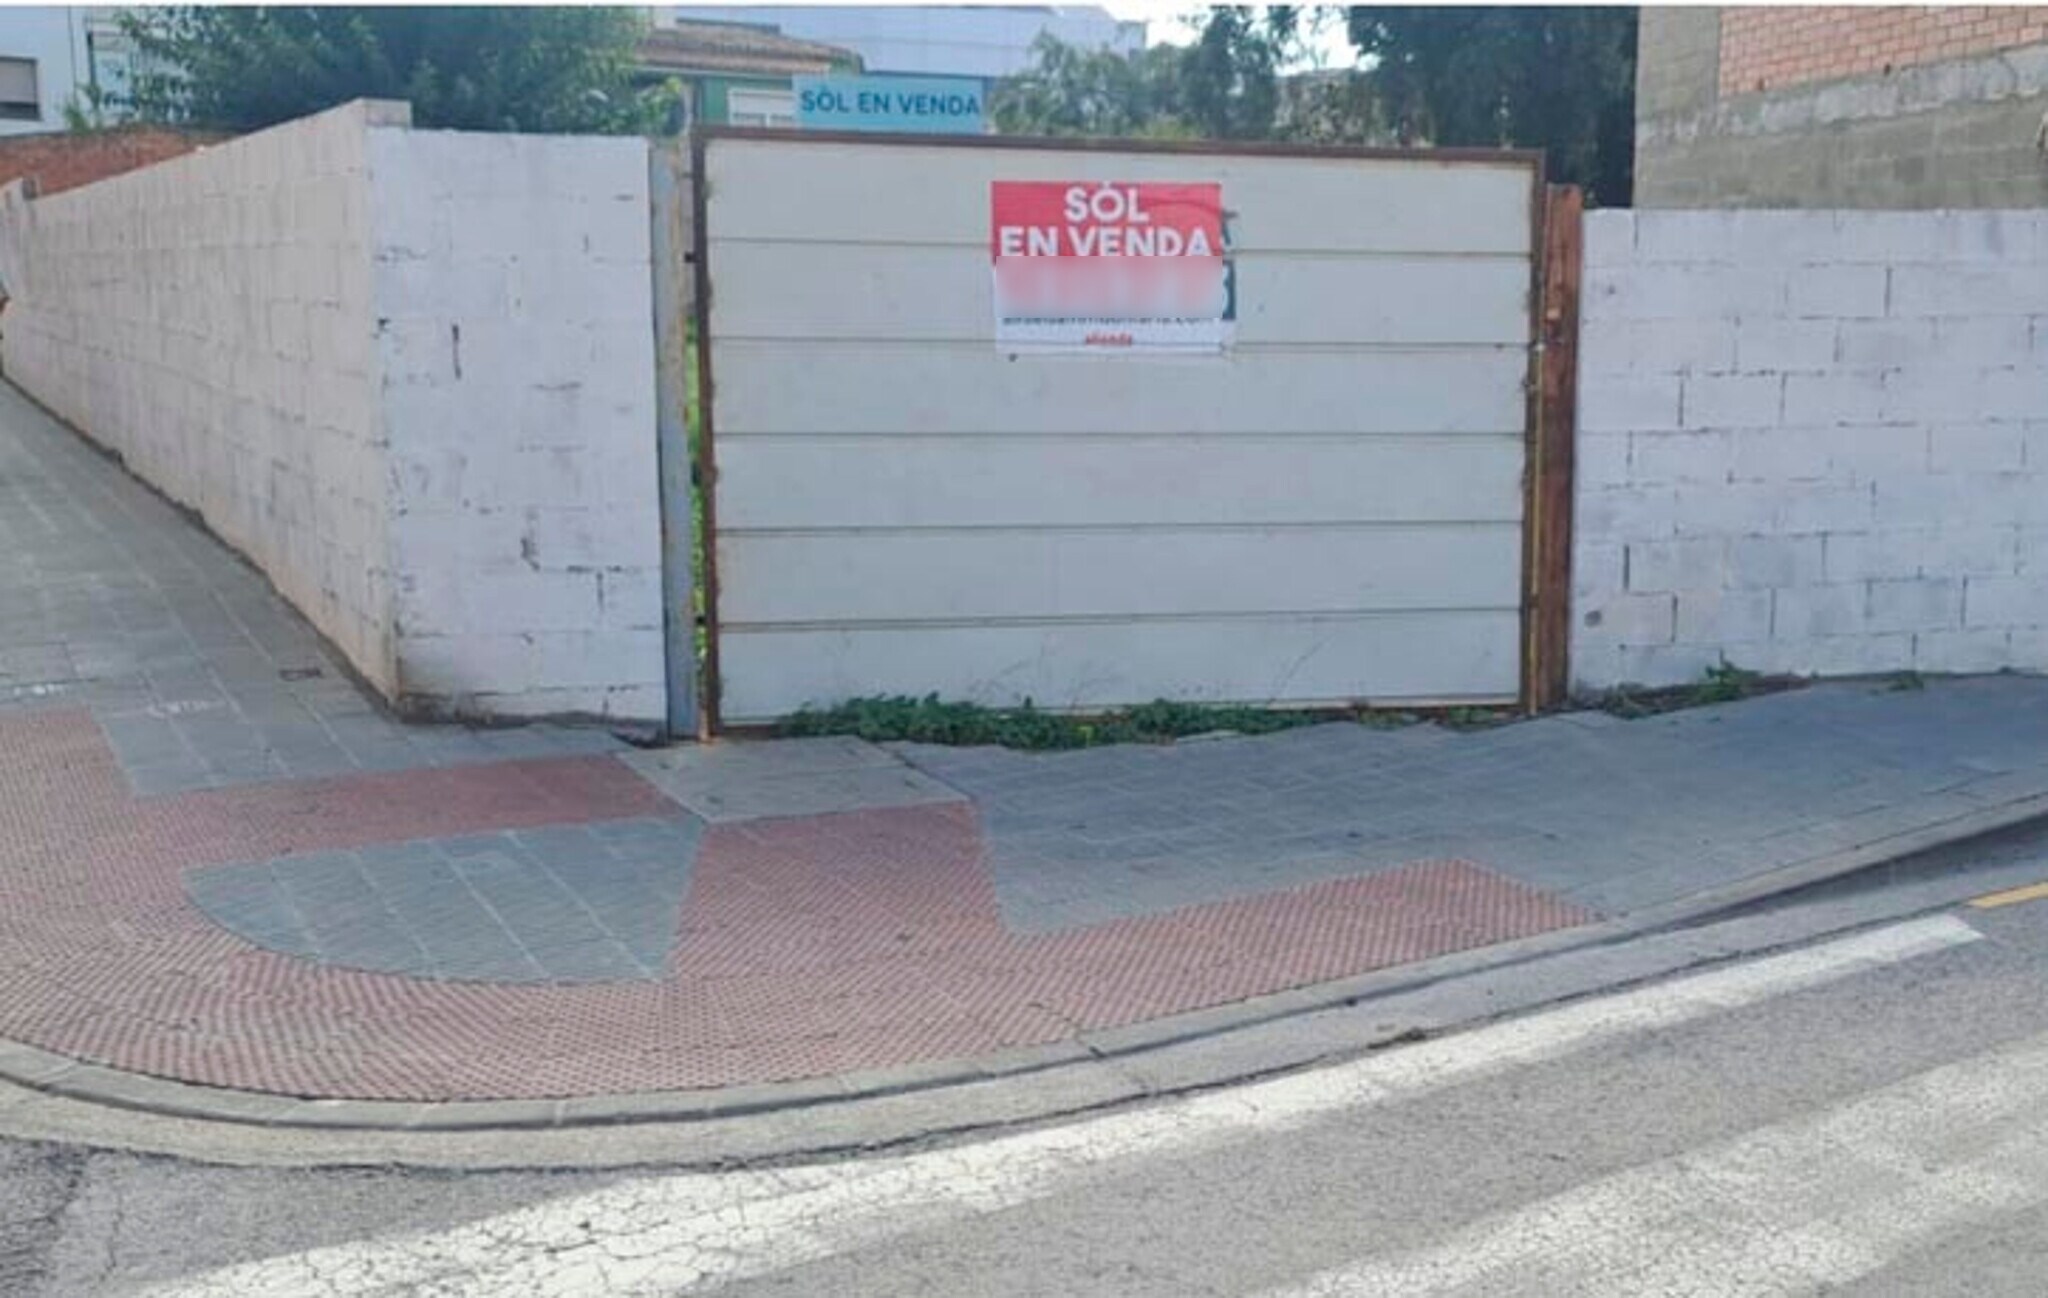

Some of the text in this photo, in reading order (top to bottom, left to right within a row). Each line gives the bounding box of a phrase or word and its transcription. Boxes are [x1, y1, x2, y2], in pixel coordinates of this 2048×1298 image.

[858, 92, 890, 114] EN
[899, 94, 979, 116] VENDA
[1000, 226, 1213, 257] EN VENDA
